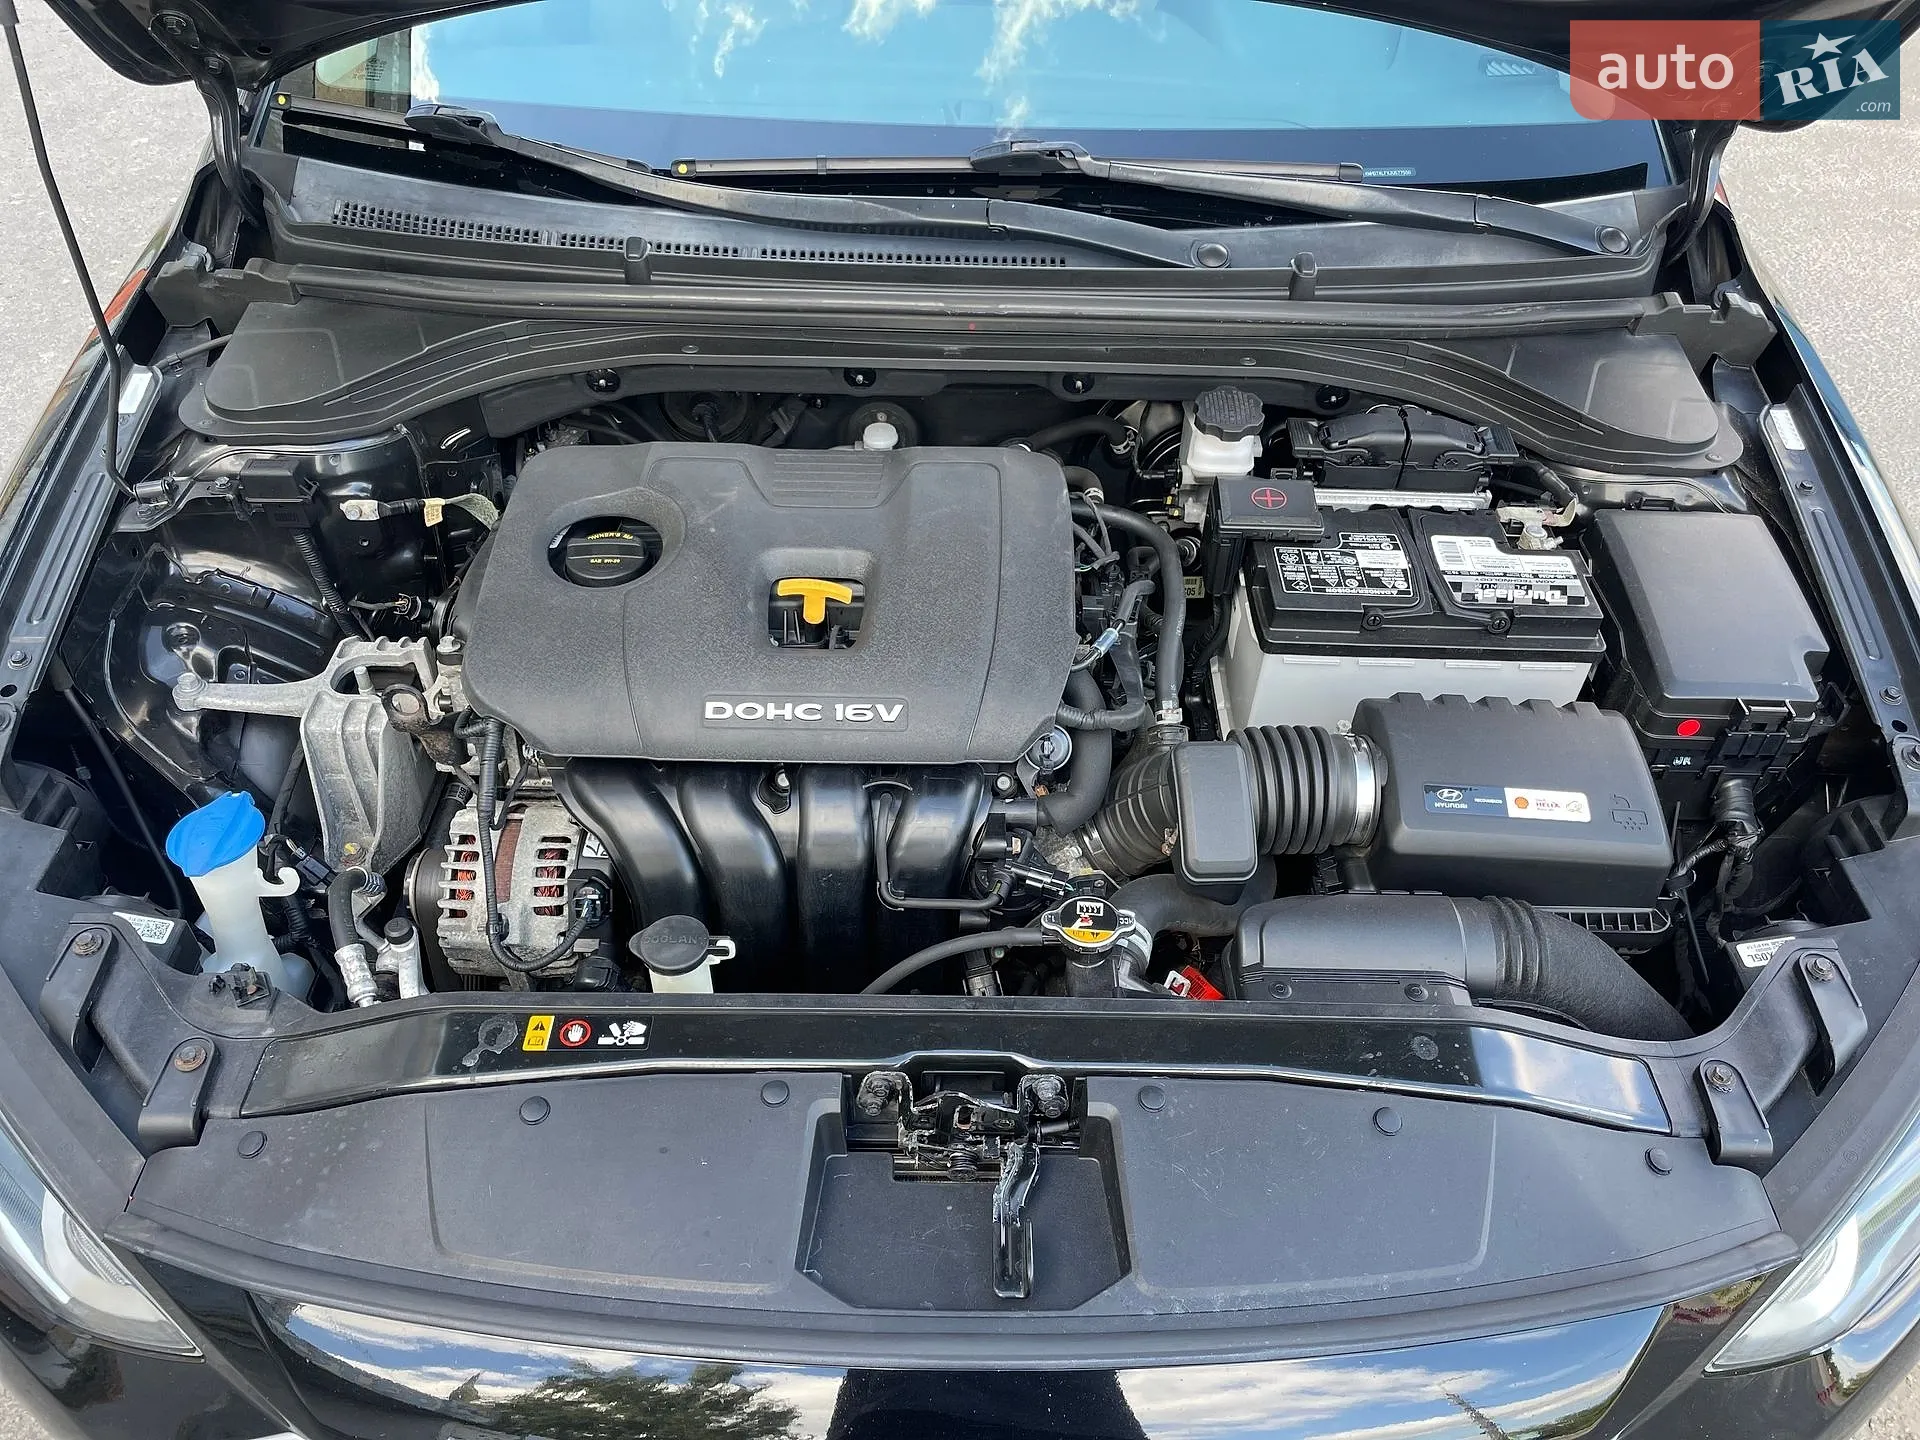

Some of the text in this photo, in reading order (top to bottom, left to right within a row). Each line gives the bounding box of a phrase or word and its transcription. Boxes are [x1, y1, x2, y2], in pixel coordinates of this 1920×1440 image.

[1474, 588, 1566, 604] Duralast
[704, 701, 904, 723] DOHC 16V
[1434, 801, 1468, 809] HYUNDAI
